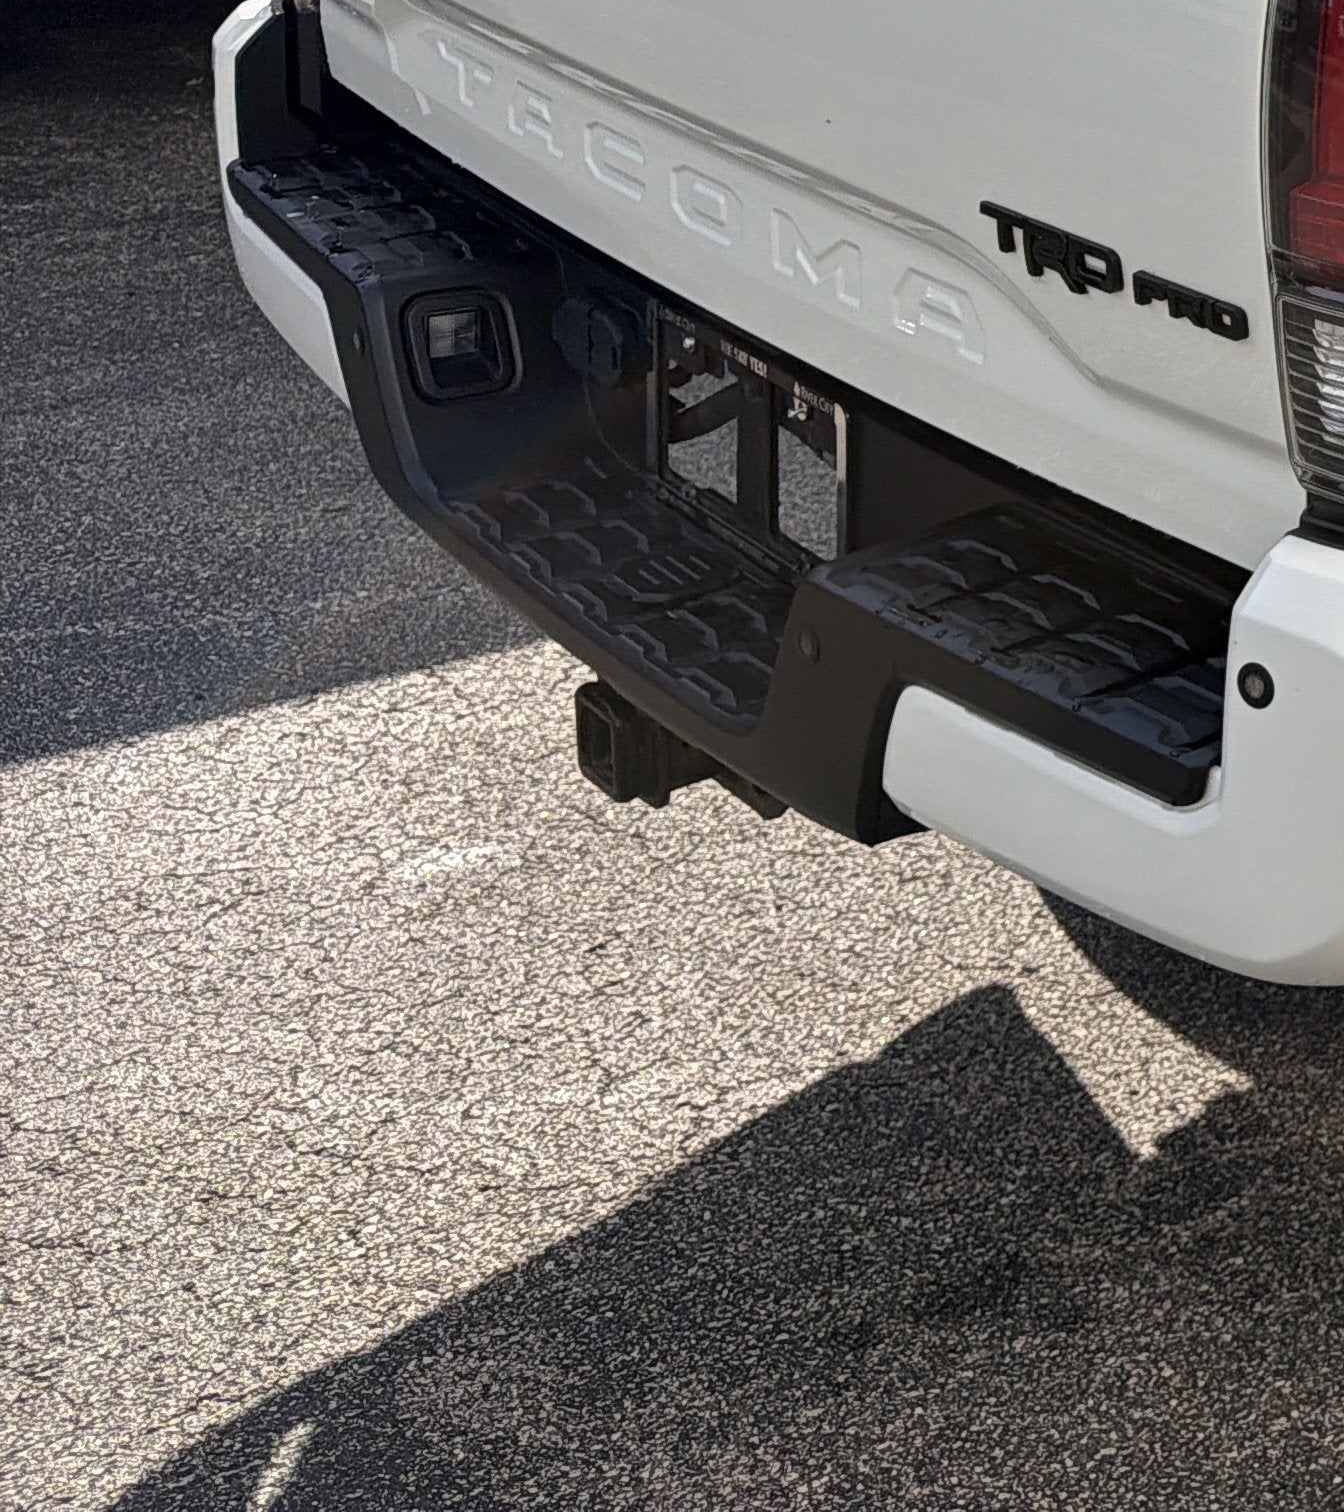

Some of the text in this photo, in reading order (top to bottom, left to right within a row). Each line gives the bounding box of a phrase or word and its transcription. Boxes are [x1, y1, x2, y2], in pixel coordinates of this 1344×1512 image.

[437, 38, 985, 365] TACOMA
[979, 200, 1250, 341] TRD PRO
